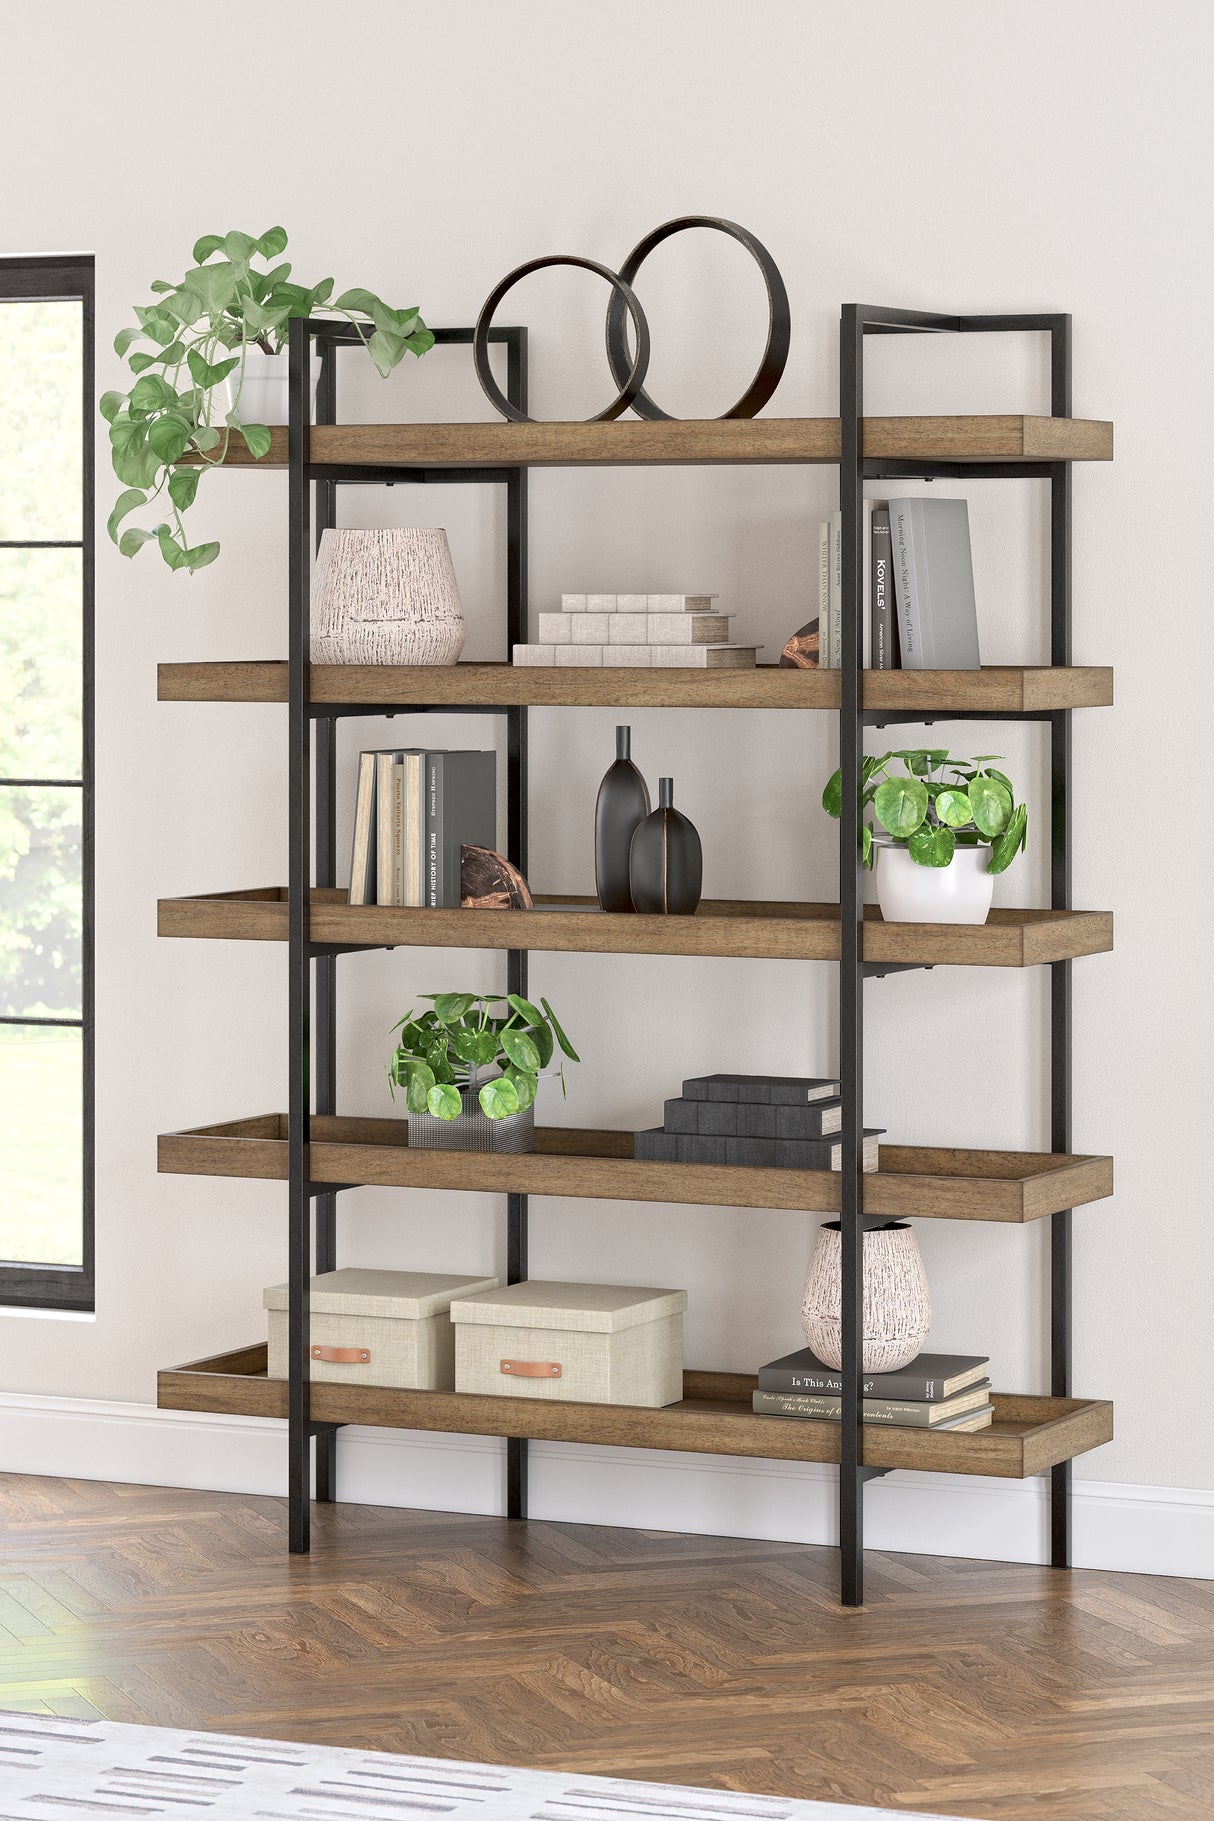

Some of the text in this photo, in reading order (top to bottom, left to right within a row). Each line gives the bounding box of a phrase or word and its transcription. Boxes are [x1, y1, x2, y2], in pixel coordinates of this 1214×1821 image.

[897, 514, 905, 546] Morning
[904, 601, 912, 616] Way
[430, 850, 436, 860] OF
[792, 1377, 801, 1386] Is
[804, 1378, 824, 1388] This
[782, 1402, 796, 1411] The
[798, 1404, 824, 1414] Origins
[826, 1407, 835, 1416] of
[863, 1411, 894, 1419] contents
